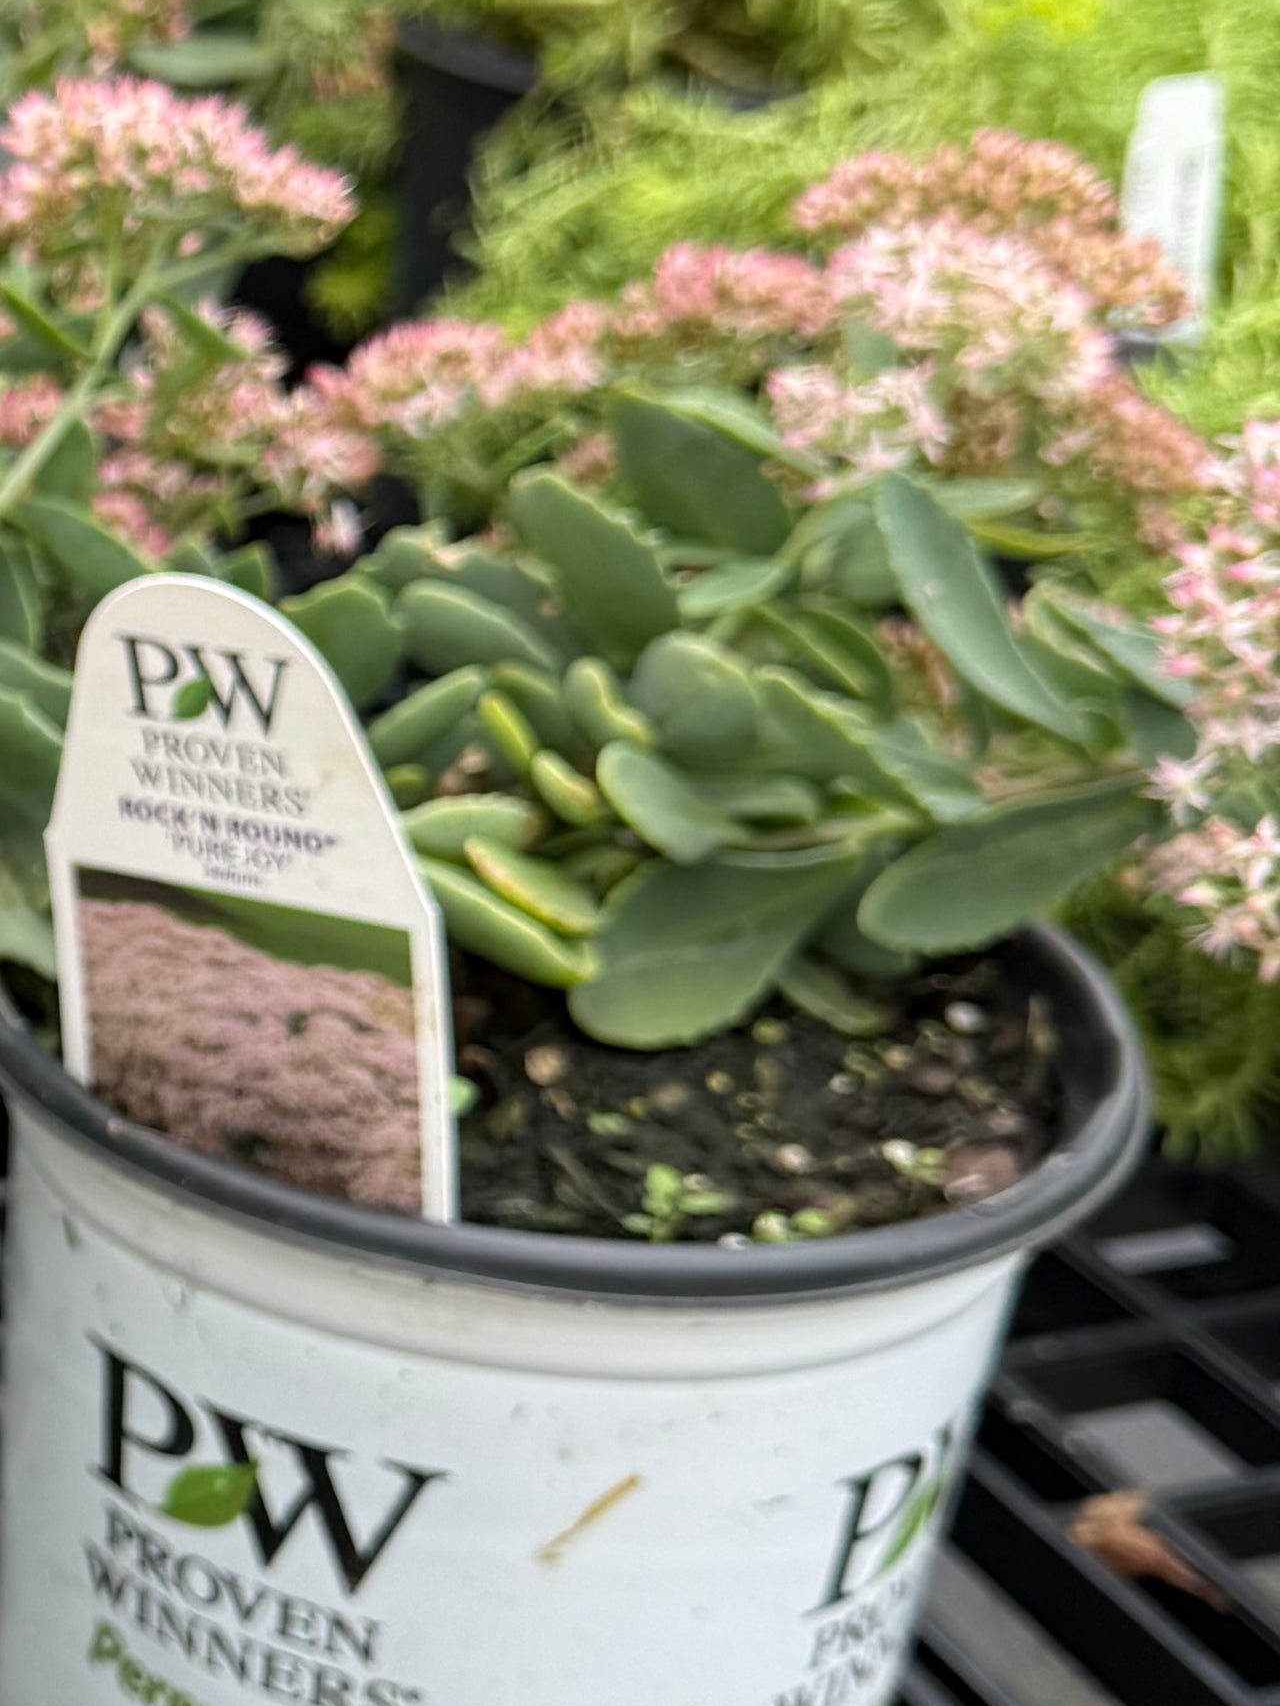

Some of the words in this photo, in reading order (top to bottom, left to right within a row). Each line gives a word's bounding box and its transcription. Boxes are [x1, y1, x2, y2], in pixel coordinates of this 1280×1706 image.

[116, 633, 292, 739] PW
[142, 725, 289, 780] PROVEN
[85, 1330, 451, 1595] PW
[104, 1502, 385, 1667] PROVEN
